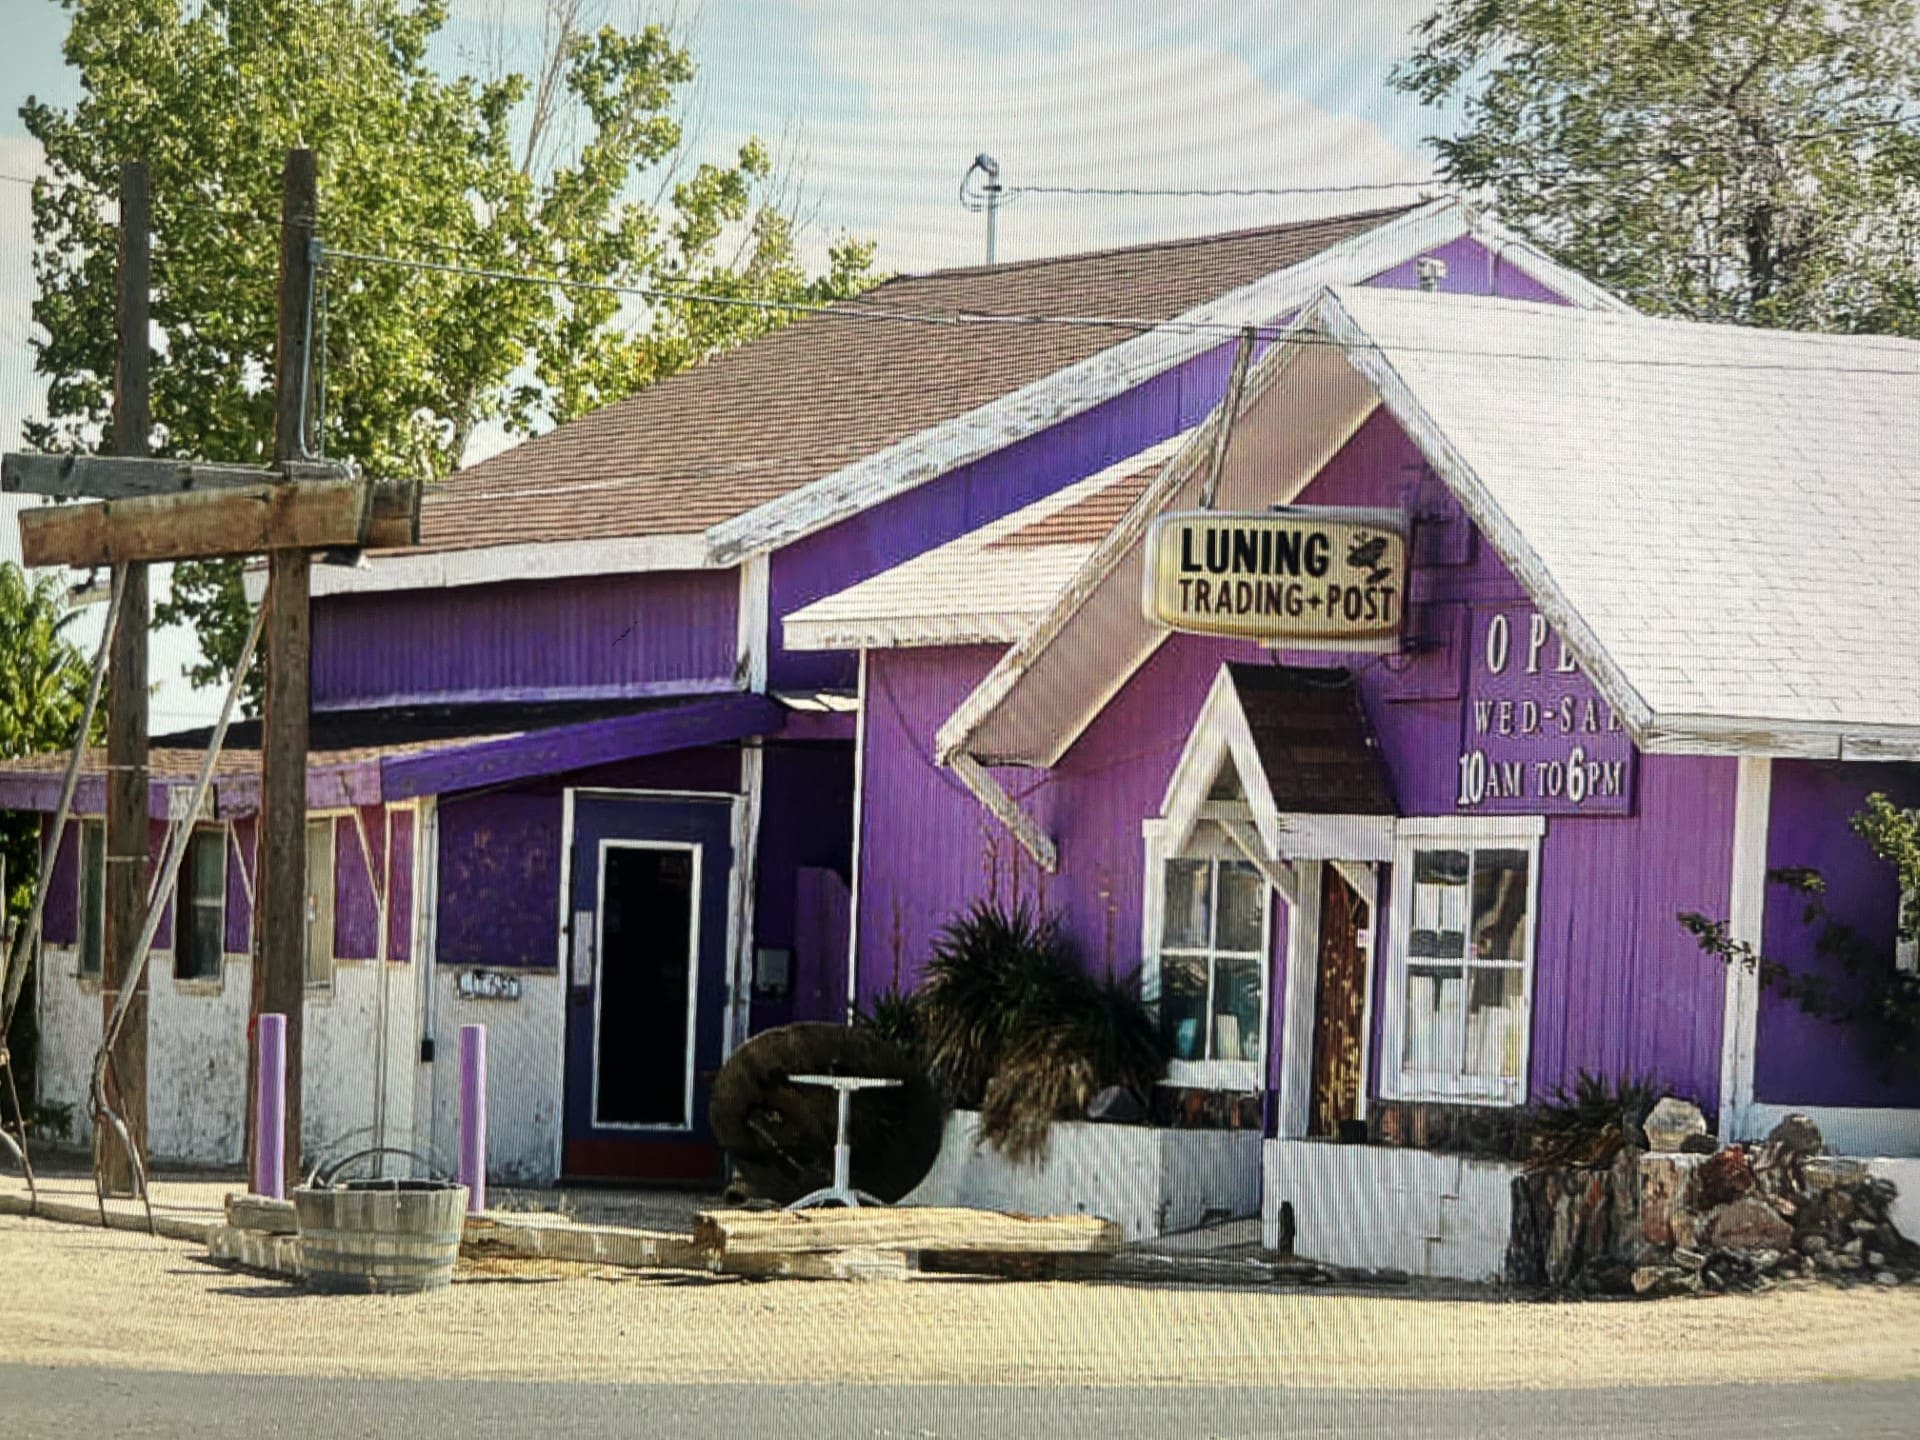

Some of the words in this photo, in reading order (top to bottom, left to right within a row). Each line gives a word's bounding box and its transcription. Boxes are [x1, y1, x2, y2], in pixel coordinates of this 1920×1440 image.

[1180, 528, 1330, 577] LUNING
[1457, 750, 1523, 805] 10AM
[1536, 761, 1564, 797] TO
[1566, 746, 1623, 803] 6PM
